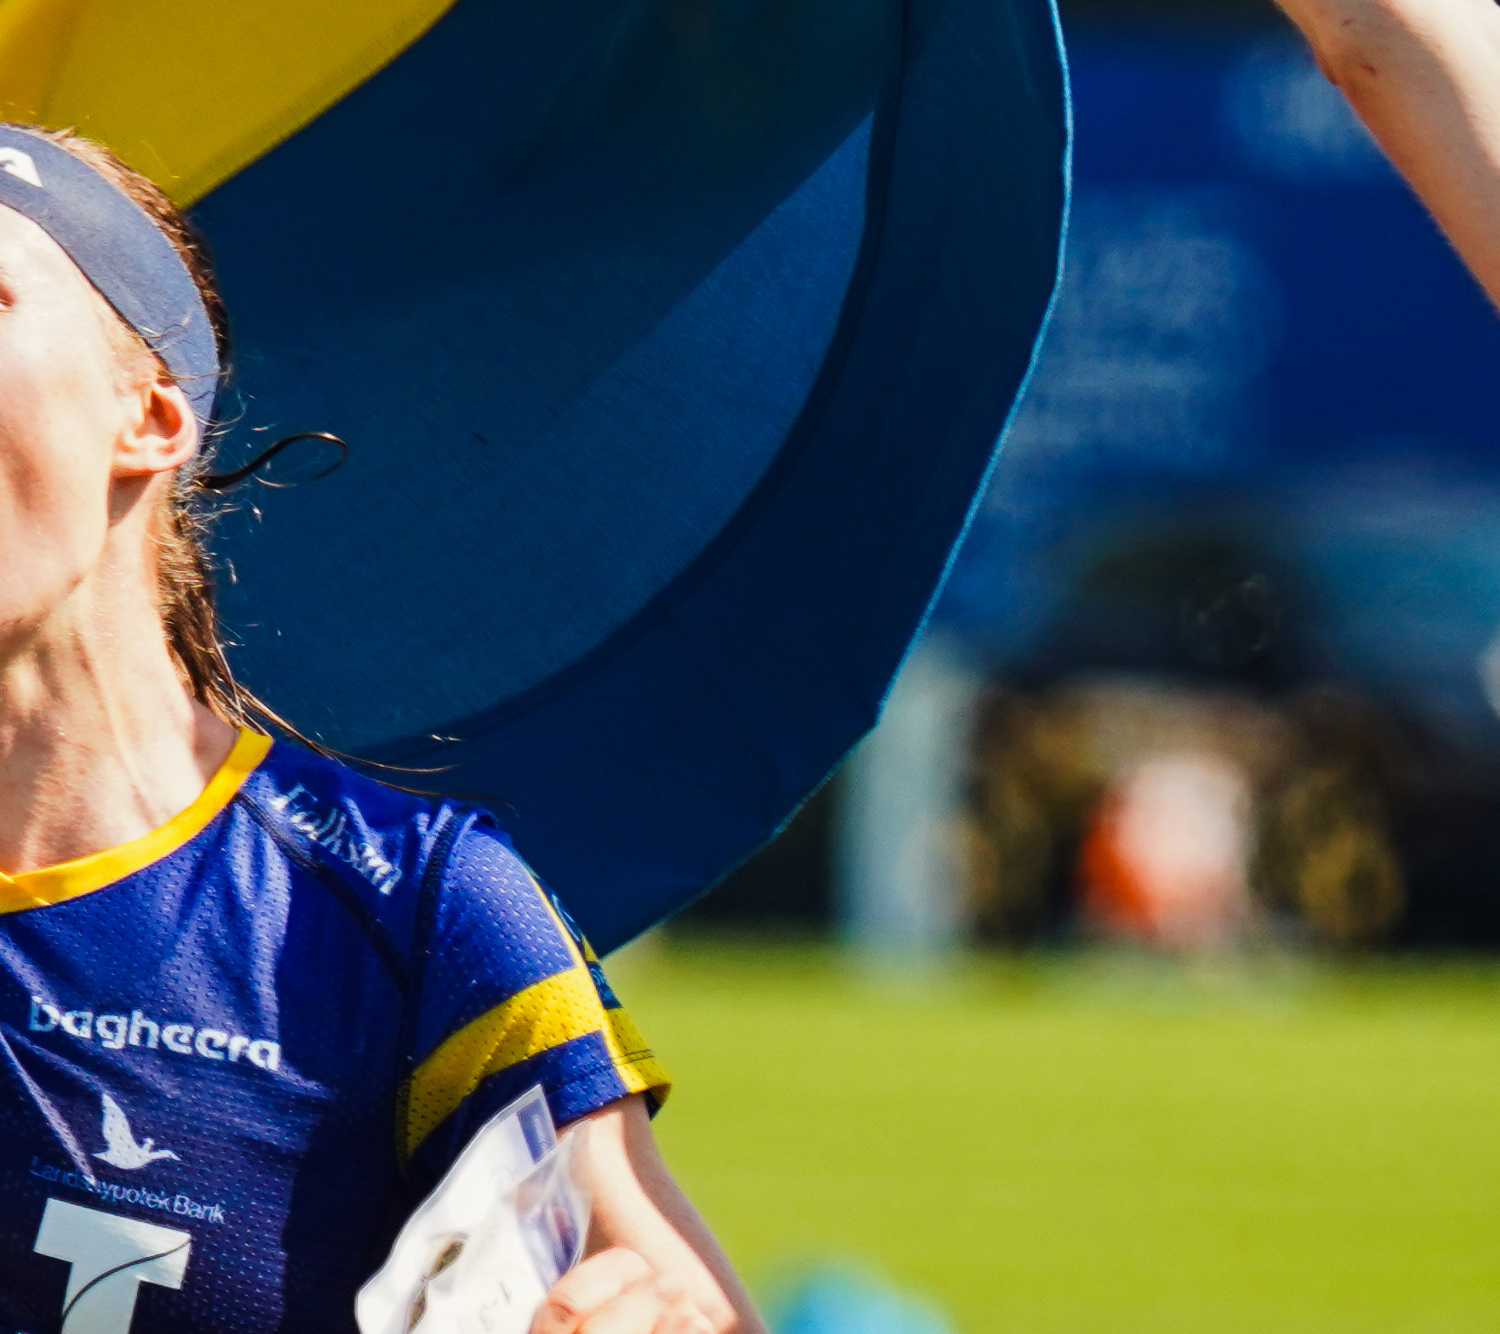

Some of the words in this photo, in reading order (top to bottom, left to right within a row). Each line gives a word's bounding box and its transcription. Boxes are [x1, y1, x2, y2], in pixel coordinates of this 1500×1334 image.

[28, 995, 282, 1072] bagheera
[29, 1156, 174, 1212] Landsypotek
[173, 1193, 226, 1225] Bank
